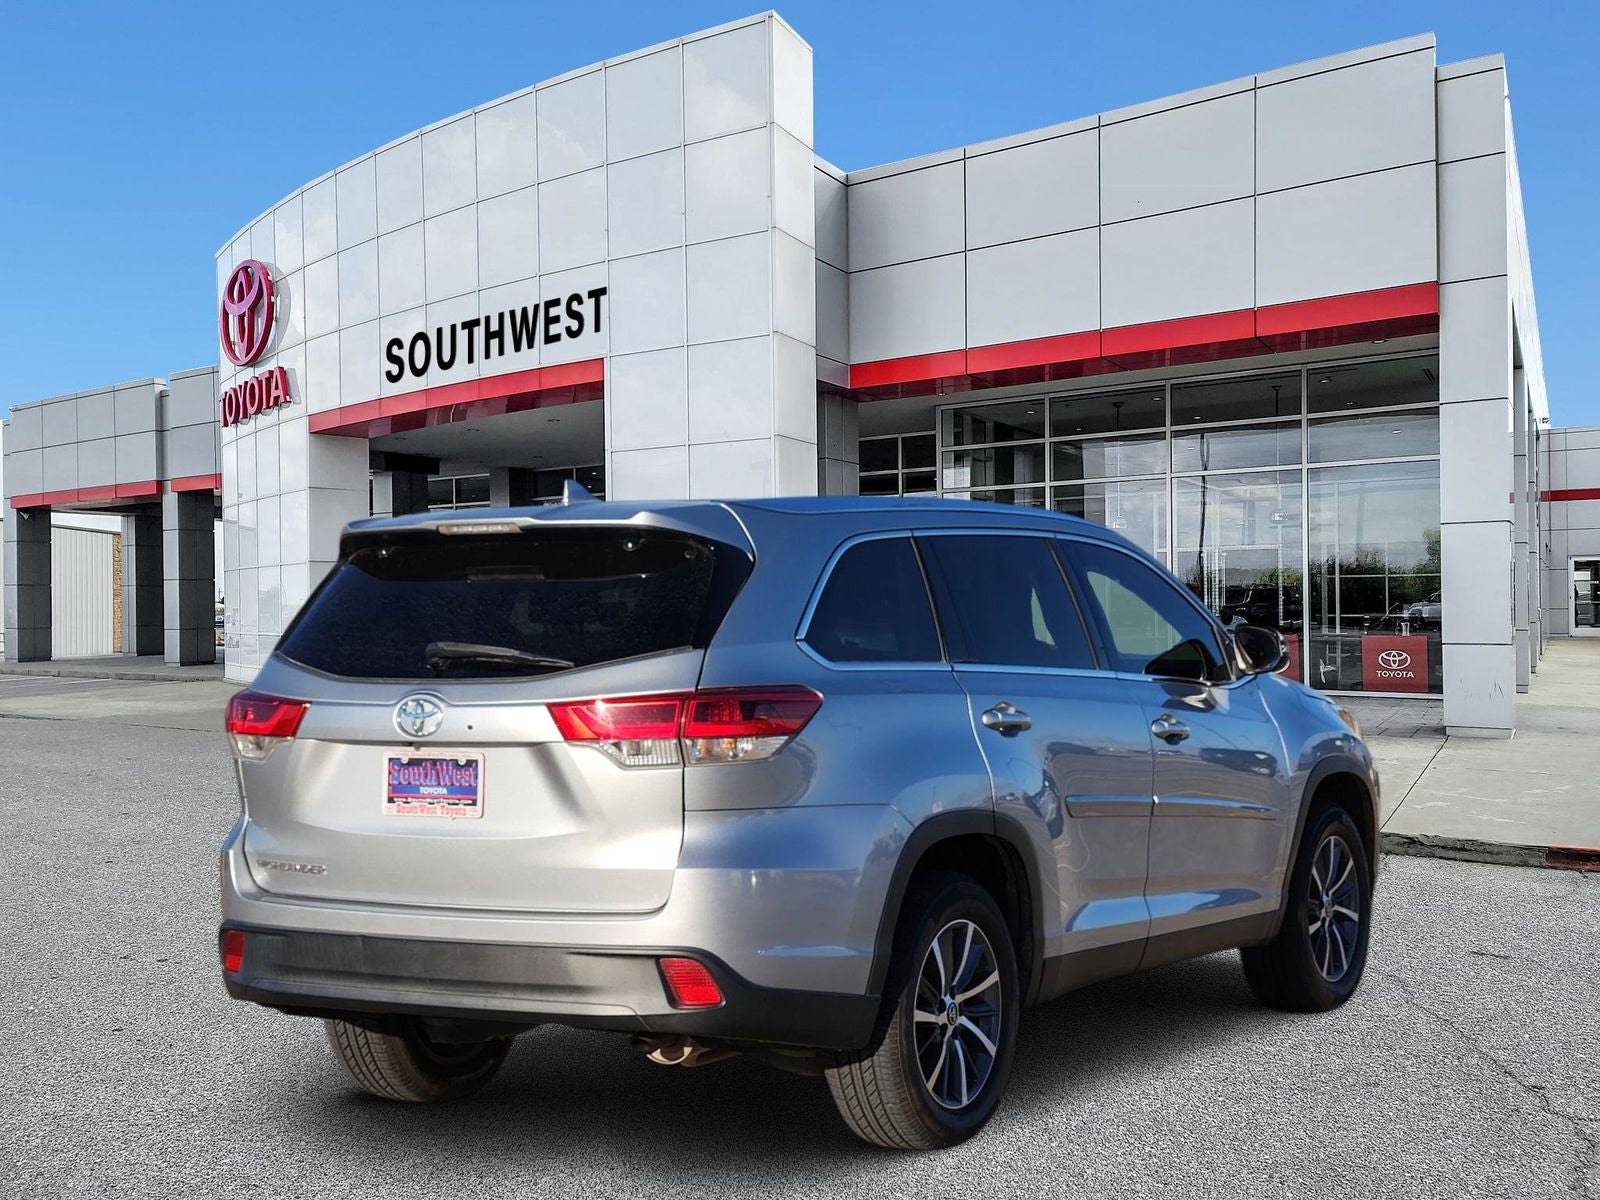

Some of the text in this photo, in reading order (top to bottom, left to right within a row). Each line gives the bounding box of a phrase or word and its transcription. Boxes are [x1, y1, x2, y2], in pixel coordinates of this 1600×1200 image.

[385, 286, 608, 384] SOUTHWEST
[219, 366, 291, 428] TOYOTA
[1375, 670, 1415, 679] TOYOTA
[419, 786, 448, 795] TOYOTA
